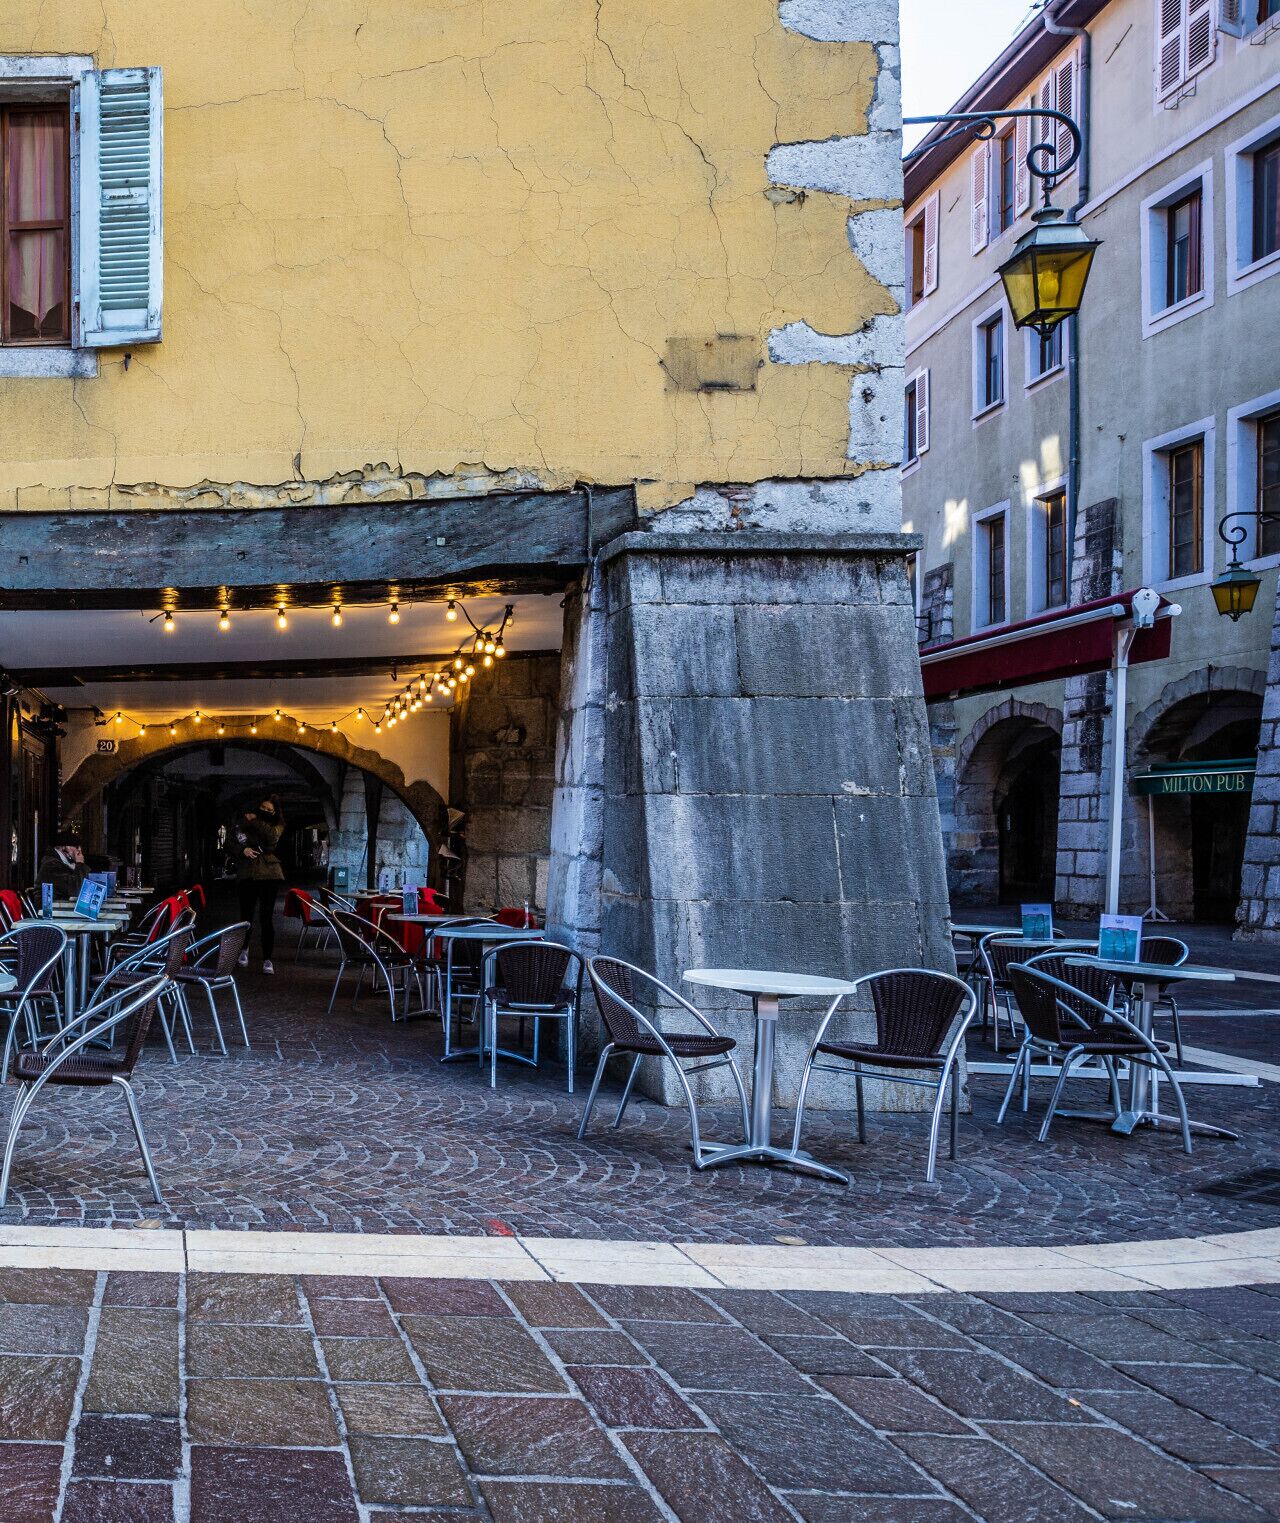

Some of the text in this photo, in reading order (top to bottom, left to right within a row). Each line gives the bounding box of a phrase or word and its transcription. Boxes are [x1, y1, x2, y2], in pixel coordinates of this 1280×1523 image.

[100, 741, 112, 750] 20
[1162, 774, 1245, 792] MILTON PUB
